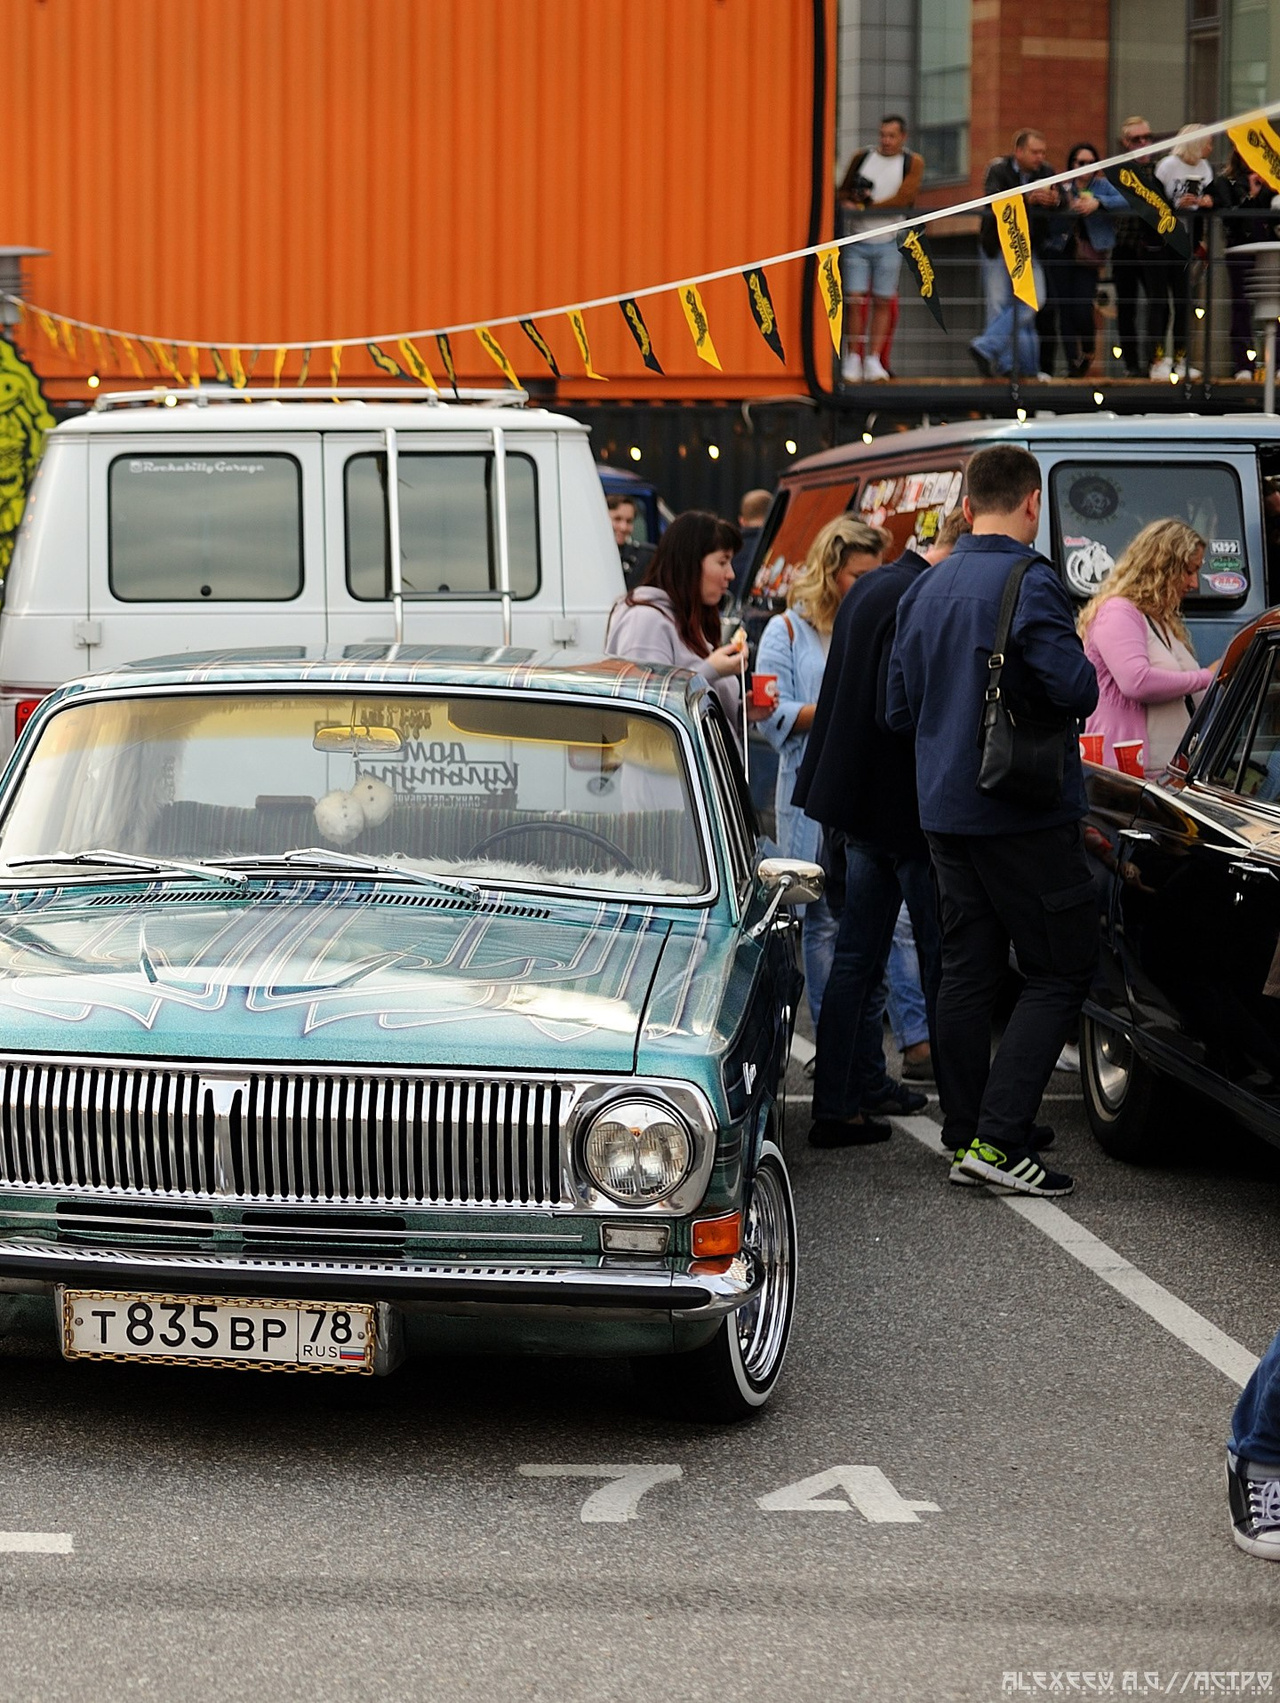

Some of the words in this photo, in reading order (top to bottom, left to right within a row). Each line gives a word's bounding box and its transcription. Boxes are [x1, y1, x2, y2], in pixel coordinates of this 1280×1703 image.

[305, 1309, 353, 1345] 78
[303, 1344, 338, 1359] RUS
[517, 1462, 944, 1524] 74
